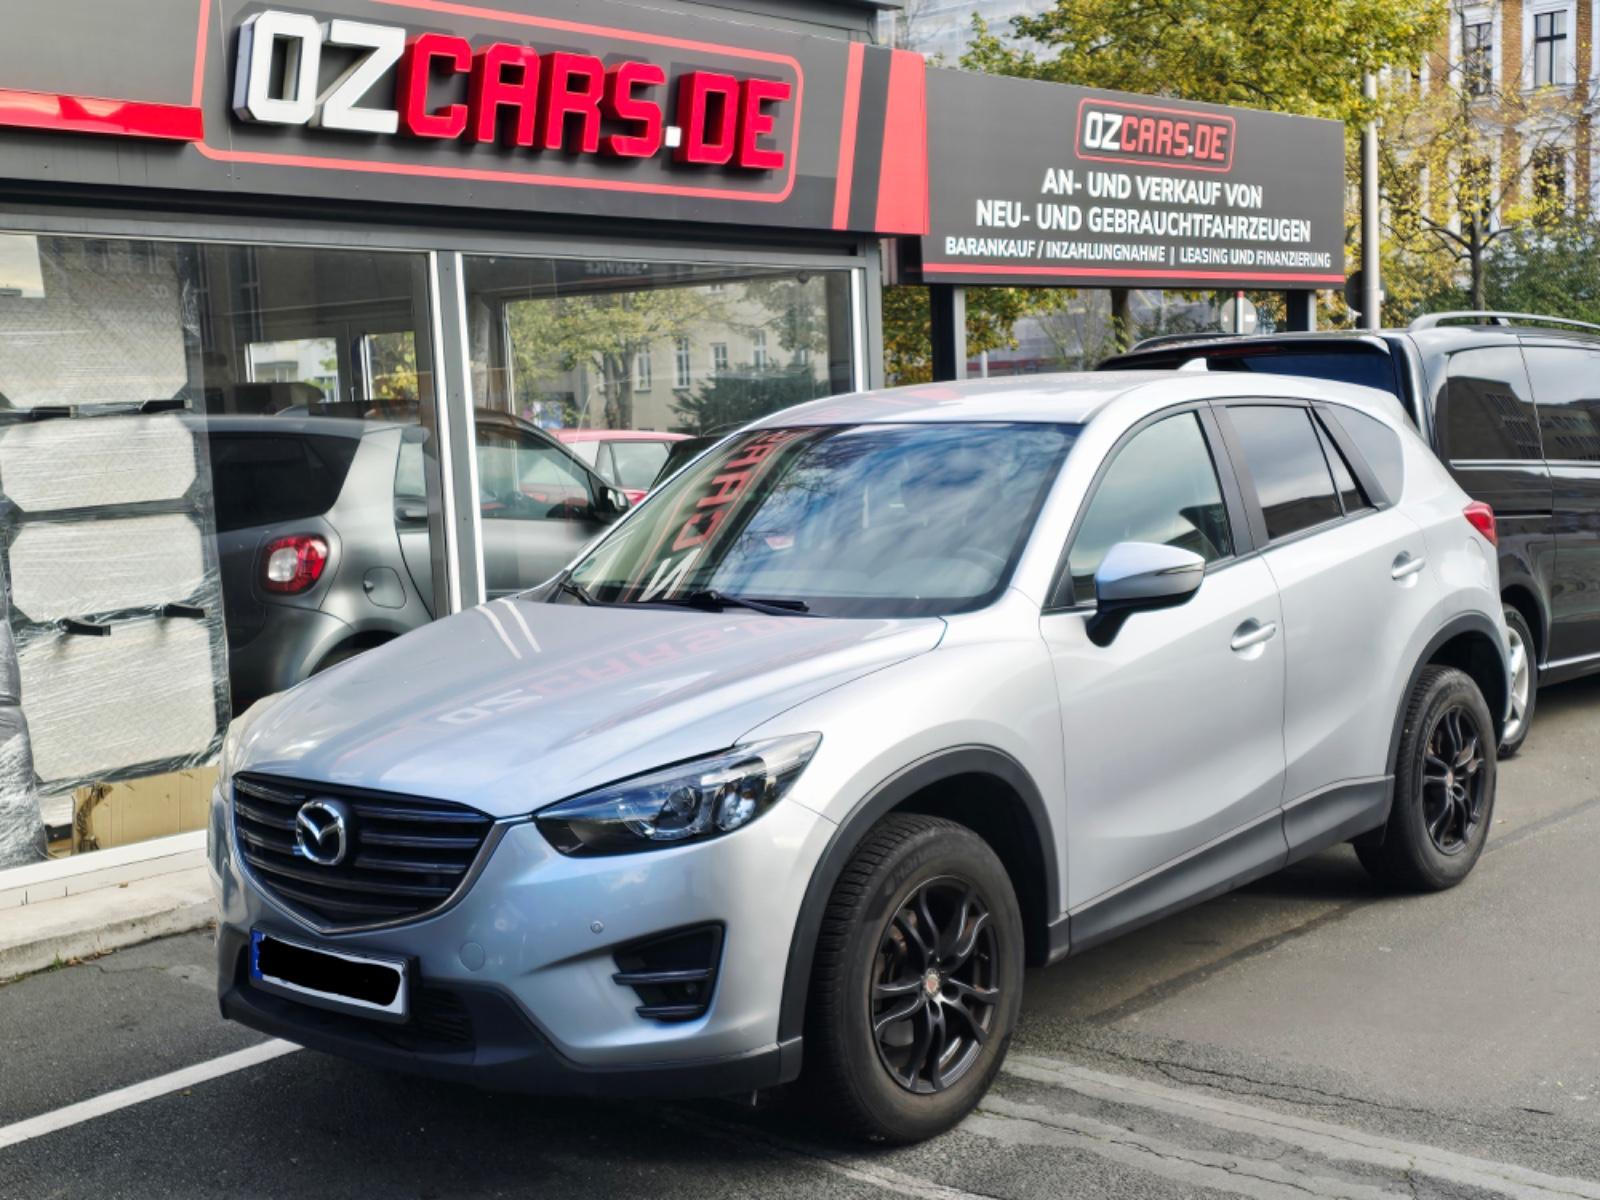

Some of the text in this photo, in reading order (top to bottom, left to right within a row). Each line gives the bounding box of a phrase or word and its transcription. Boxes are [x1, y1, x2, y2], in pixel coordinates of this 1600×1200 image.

[232, 10, 792, 170] OZCARS.DE
[1083, 111, 1229, 160] OZCARS.DE
[1041, 168, 1263, 208] AN- UND VERKAUF VON
[976, 199, 1311, 242] NEU- UND GEBRAUCHTFAHRZEUGEN
[944, 236, 1036, 258] BARANKAUF
[1046, 241, 1166, 262] INZAHLUNGNAHME
[1180, 246, 1229, 264] LEASING
[1230, 250, 1255, 265] UND
[1256, 251, 1331, 268] FINANZIERUNG
